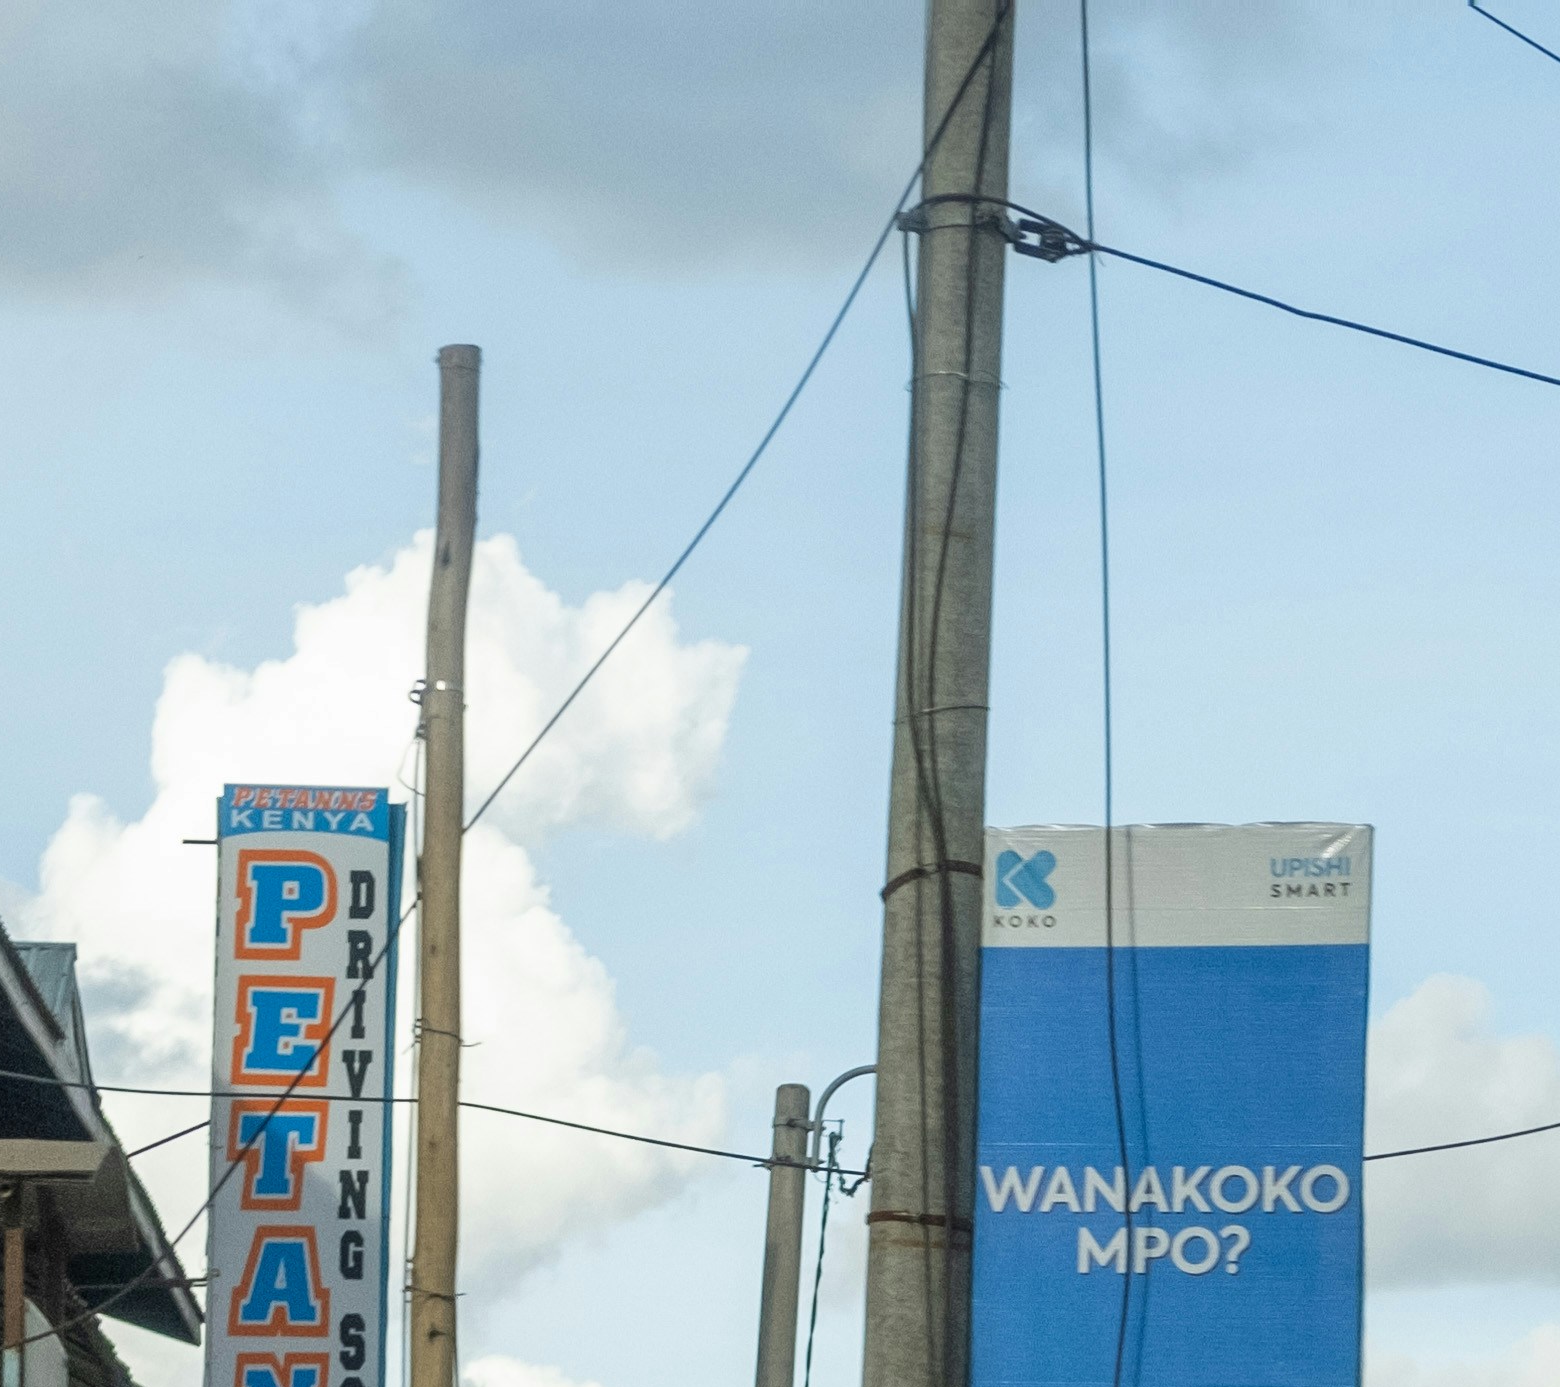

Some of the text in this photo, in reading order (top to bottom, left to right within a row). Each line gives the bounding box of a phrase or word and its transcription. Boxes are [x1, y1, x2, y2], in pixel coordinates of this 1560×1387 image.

[232, 787, 378, 811] PETANNS
[230, 809, 374, 832] KENYA
[1270, 857, 1351, 878] UPISHI
[1270, 882, 1351, 899] SMART
[993, 914, 1058, 929] KOKO
[337, 870, 375, 1281] DRIVING
[980, 1165, 1351, 1214] WANAKOKO
[1077, 1225, 1251, 1275] MPO?
